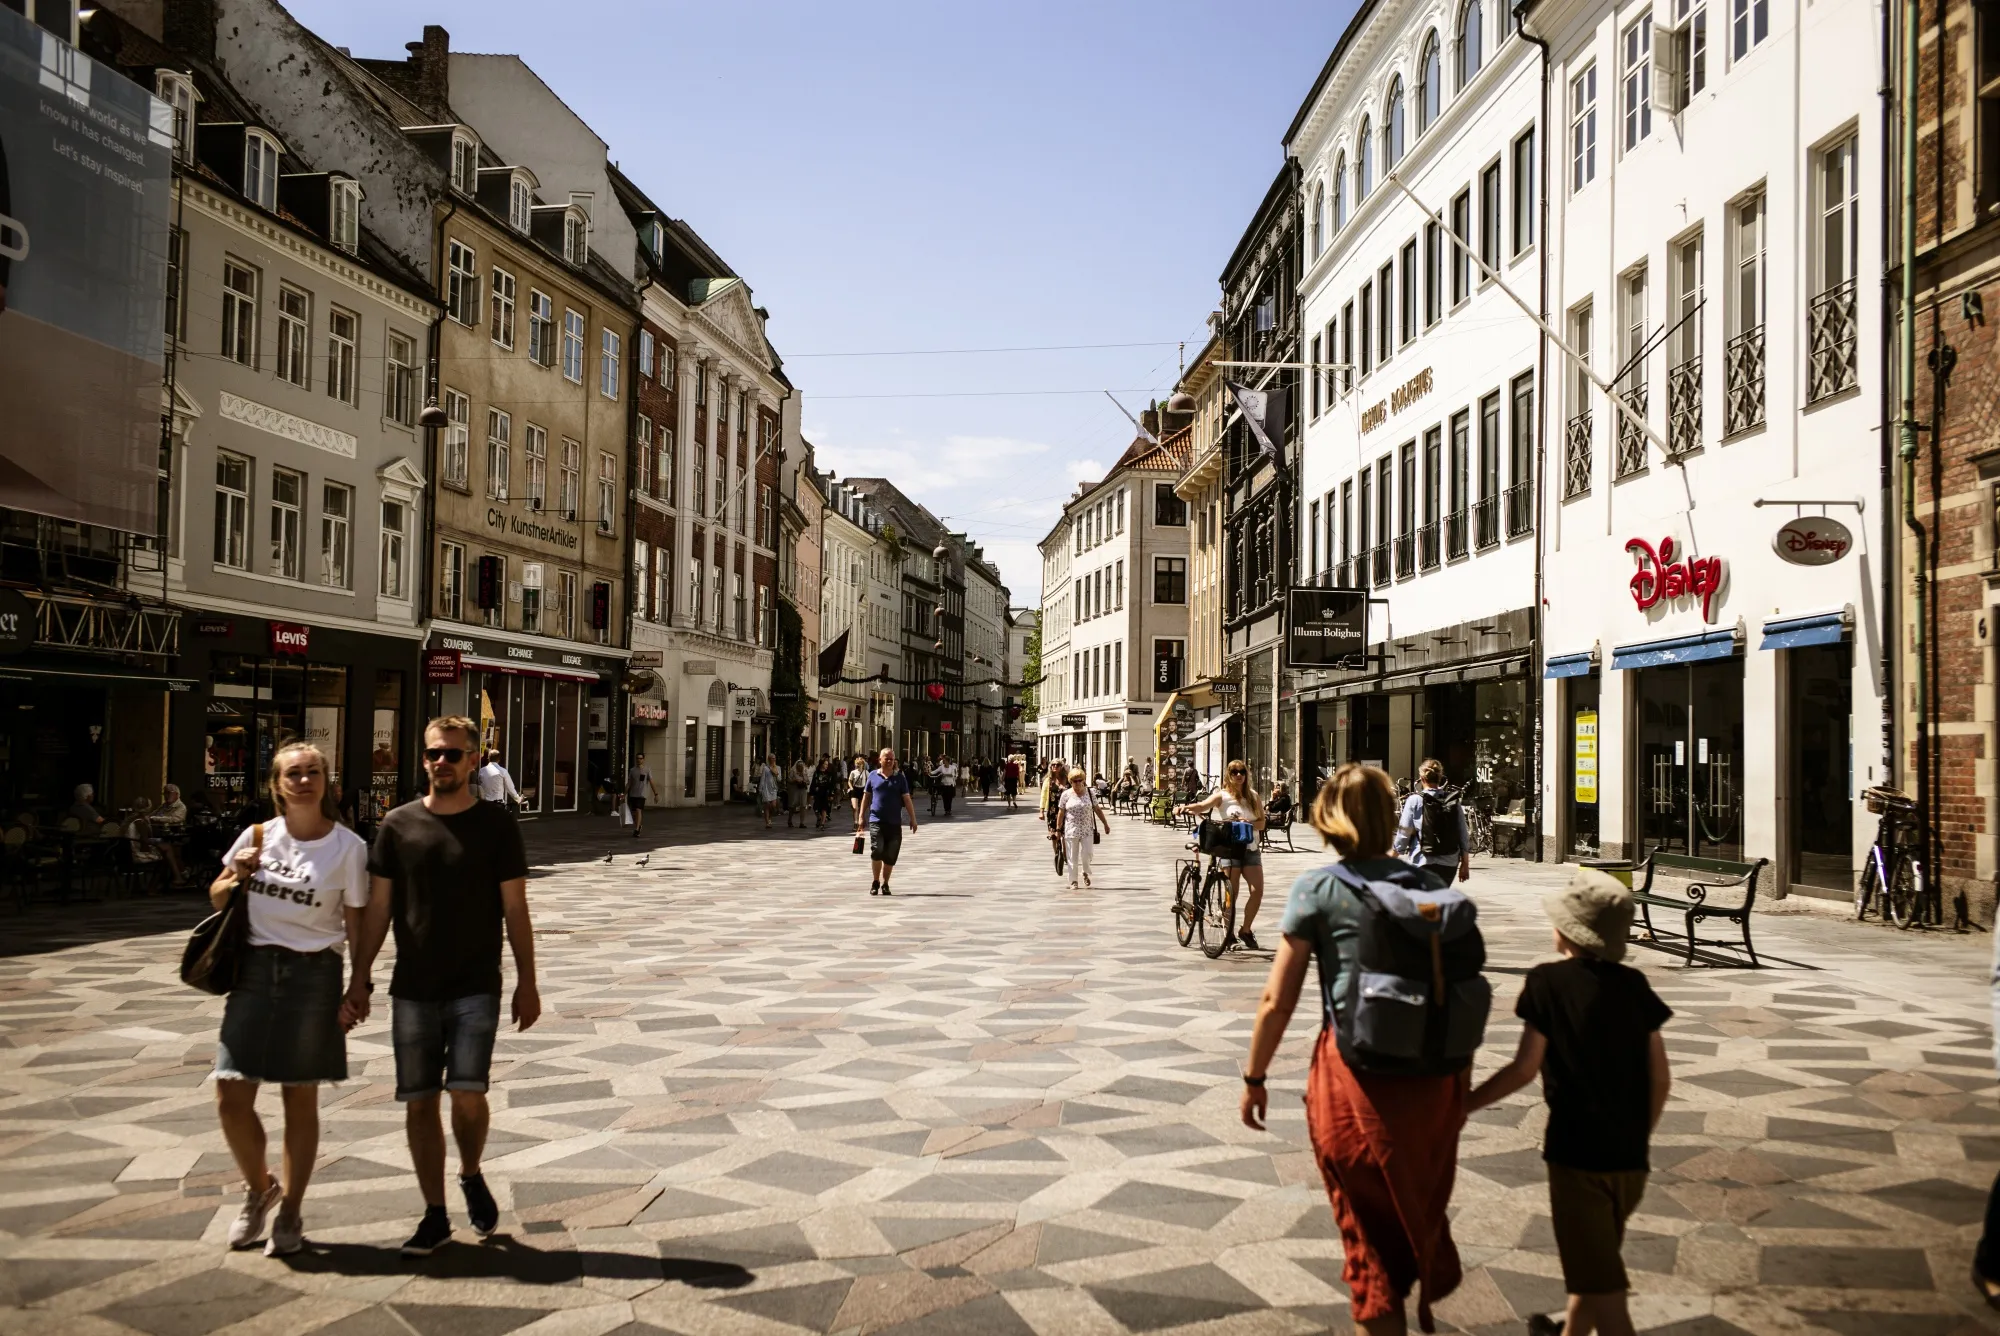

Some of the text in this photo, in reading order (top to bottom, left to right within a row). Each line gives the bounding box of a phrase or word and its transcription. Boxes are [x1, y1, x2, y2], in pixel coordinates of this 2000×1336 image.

[39, 99, 147, 167] know it has changed.
[67, 97, 148, 146] The world as we
[53, 137, 145, 195] Let's stay inspired.
[487, 507, 578, 550] City KunstnerArtikler
[1777, 528, 1847, 560] Disney
[1624, 535, 1722, 624] Disney
[1294, 626, 1362, 640] Illums Bolighus
[1978, 617, 1987, 640] 6
[442, 637, 474, 652] SOUVENIRS
[508, 647, 534, 660] EXCHANGE
[562, 655, 582, 667] LUGGAGE
[1160, 660, 1168, 683] Orbit
[735, 708, 756, 717] コハク
[209, 776, 246, 788] 50% OFF
[372, 775, 399, 785] 50% OFF
[1476, 768, 1493, 783] SALE
[247, 877, 323, 908] merci.
